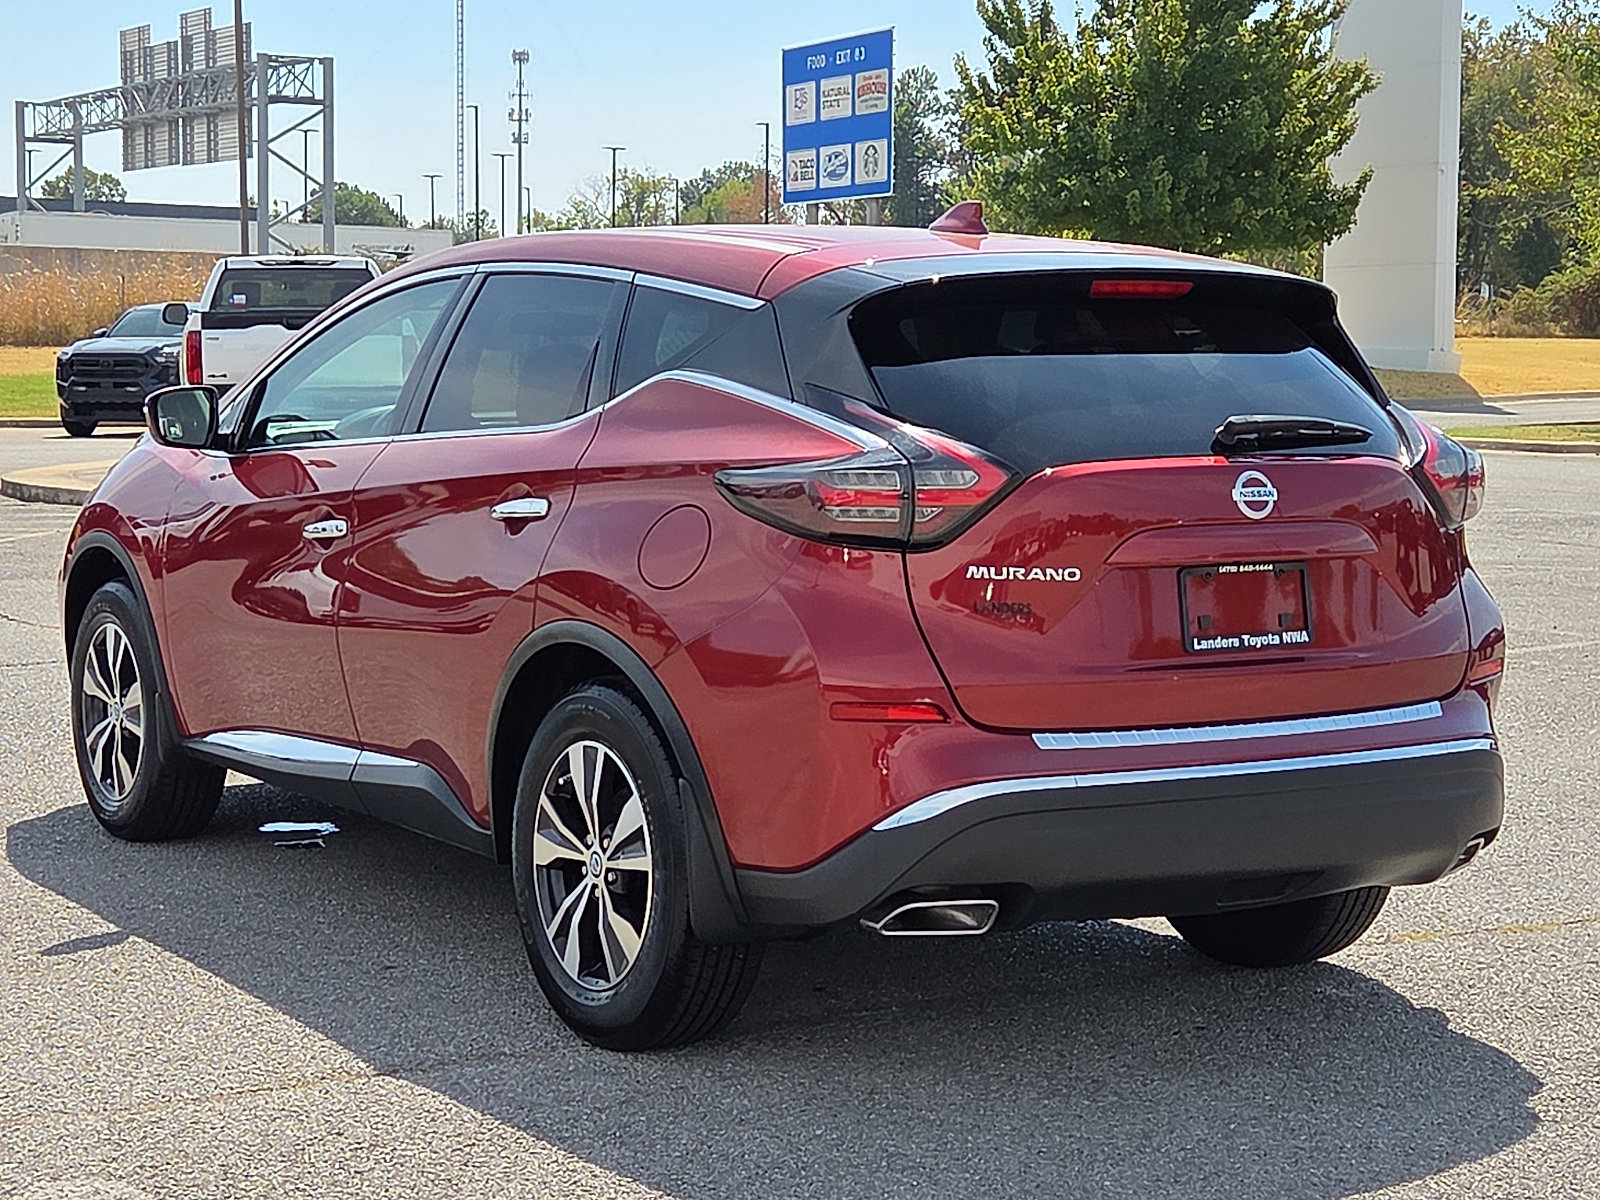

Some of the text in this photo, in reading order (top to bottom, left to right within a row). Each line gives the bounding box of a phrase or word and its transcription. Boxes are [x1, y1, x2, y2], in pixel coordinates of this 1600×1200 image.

[806, 54, 826, 70] FOOD
[836, 49, 851, 65] EXIT
[822, 86, 851, 98] NATURAL
[822, 98, 841, 110] STATE
[798, 158, 815, 169] TACO
[799, 170, 815, 181] BELL
[1239, 490, 1274, 498] NISSAN
[965, 565, 1081, 581] MURANO
[973, 601, 1032, 616] LANDERS
[1193, 630, 1310, 650] Landers Toyota NWA
